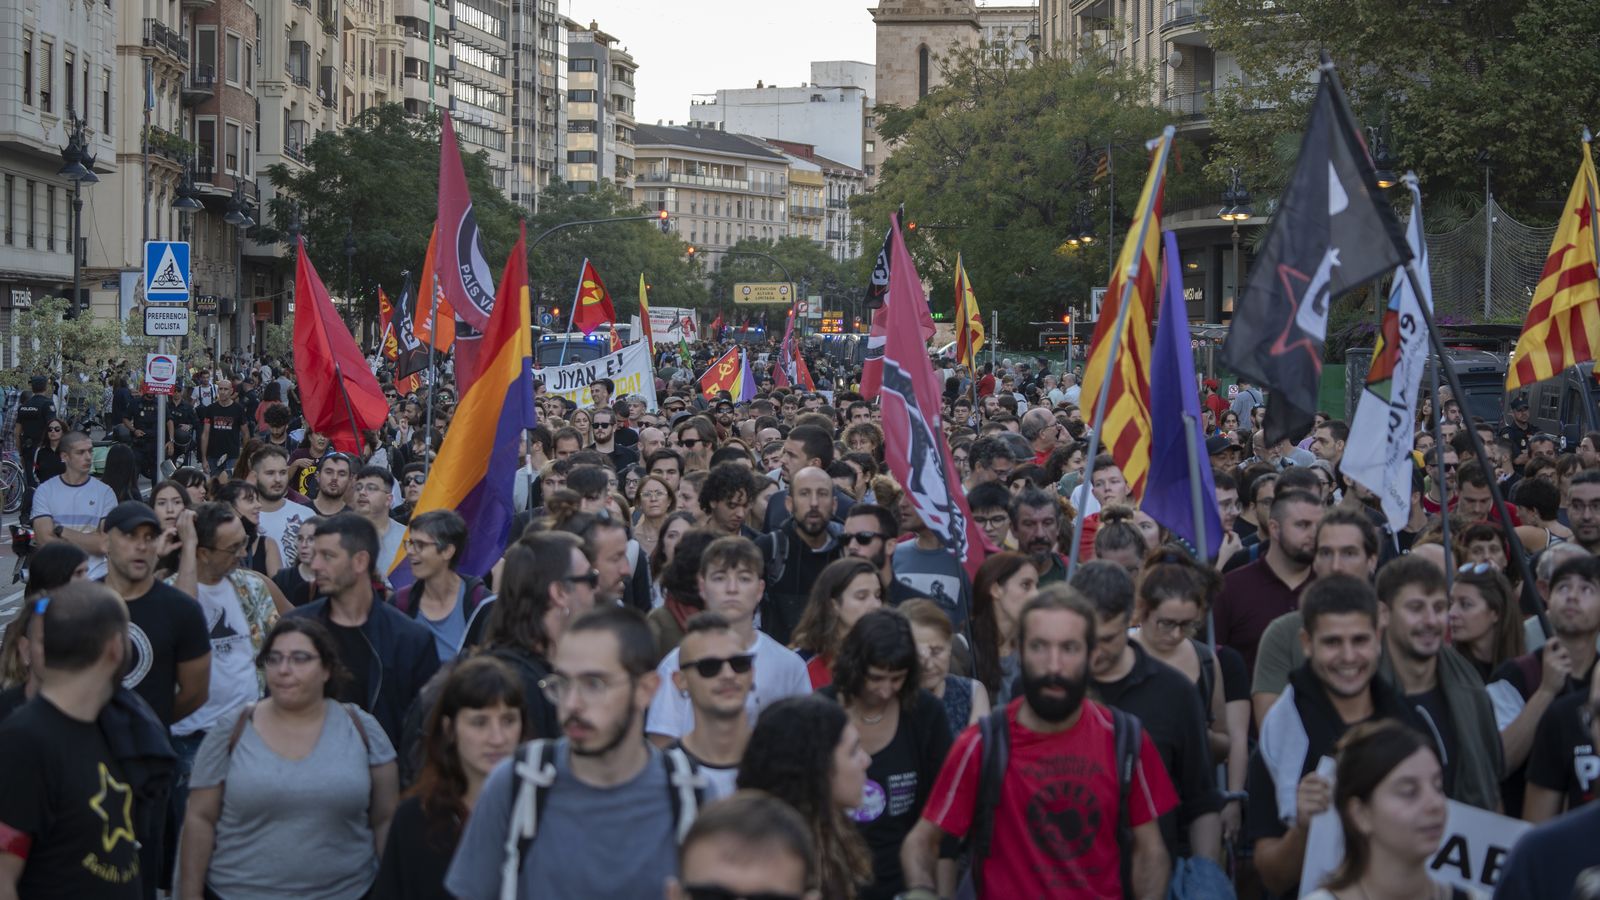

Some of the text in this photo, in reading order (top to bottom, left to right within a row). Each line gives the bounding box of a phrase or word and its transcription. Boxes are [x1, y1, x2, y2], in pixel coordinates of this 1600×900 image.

[461, 263, 480, 297] PAÍS
[147, 312, 187, 320] PREFERENCIA
[154, 322, 181, 330] CICLISTA
[612, 371, 641, 395] IDA!
